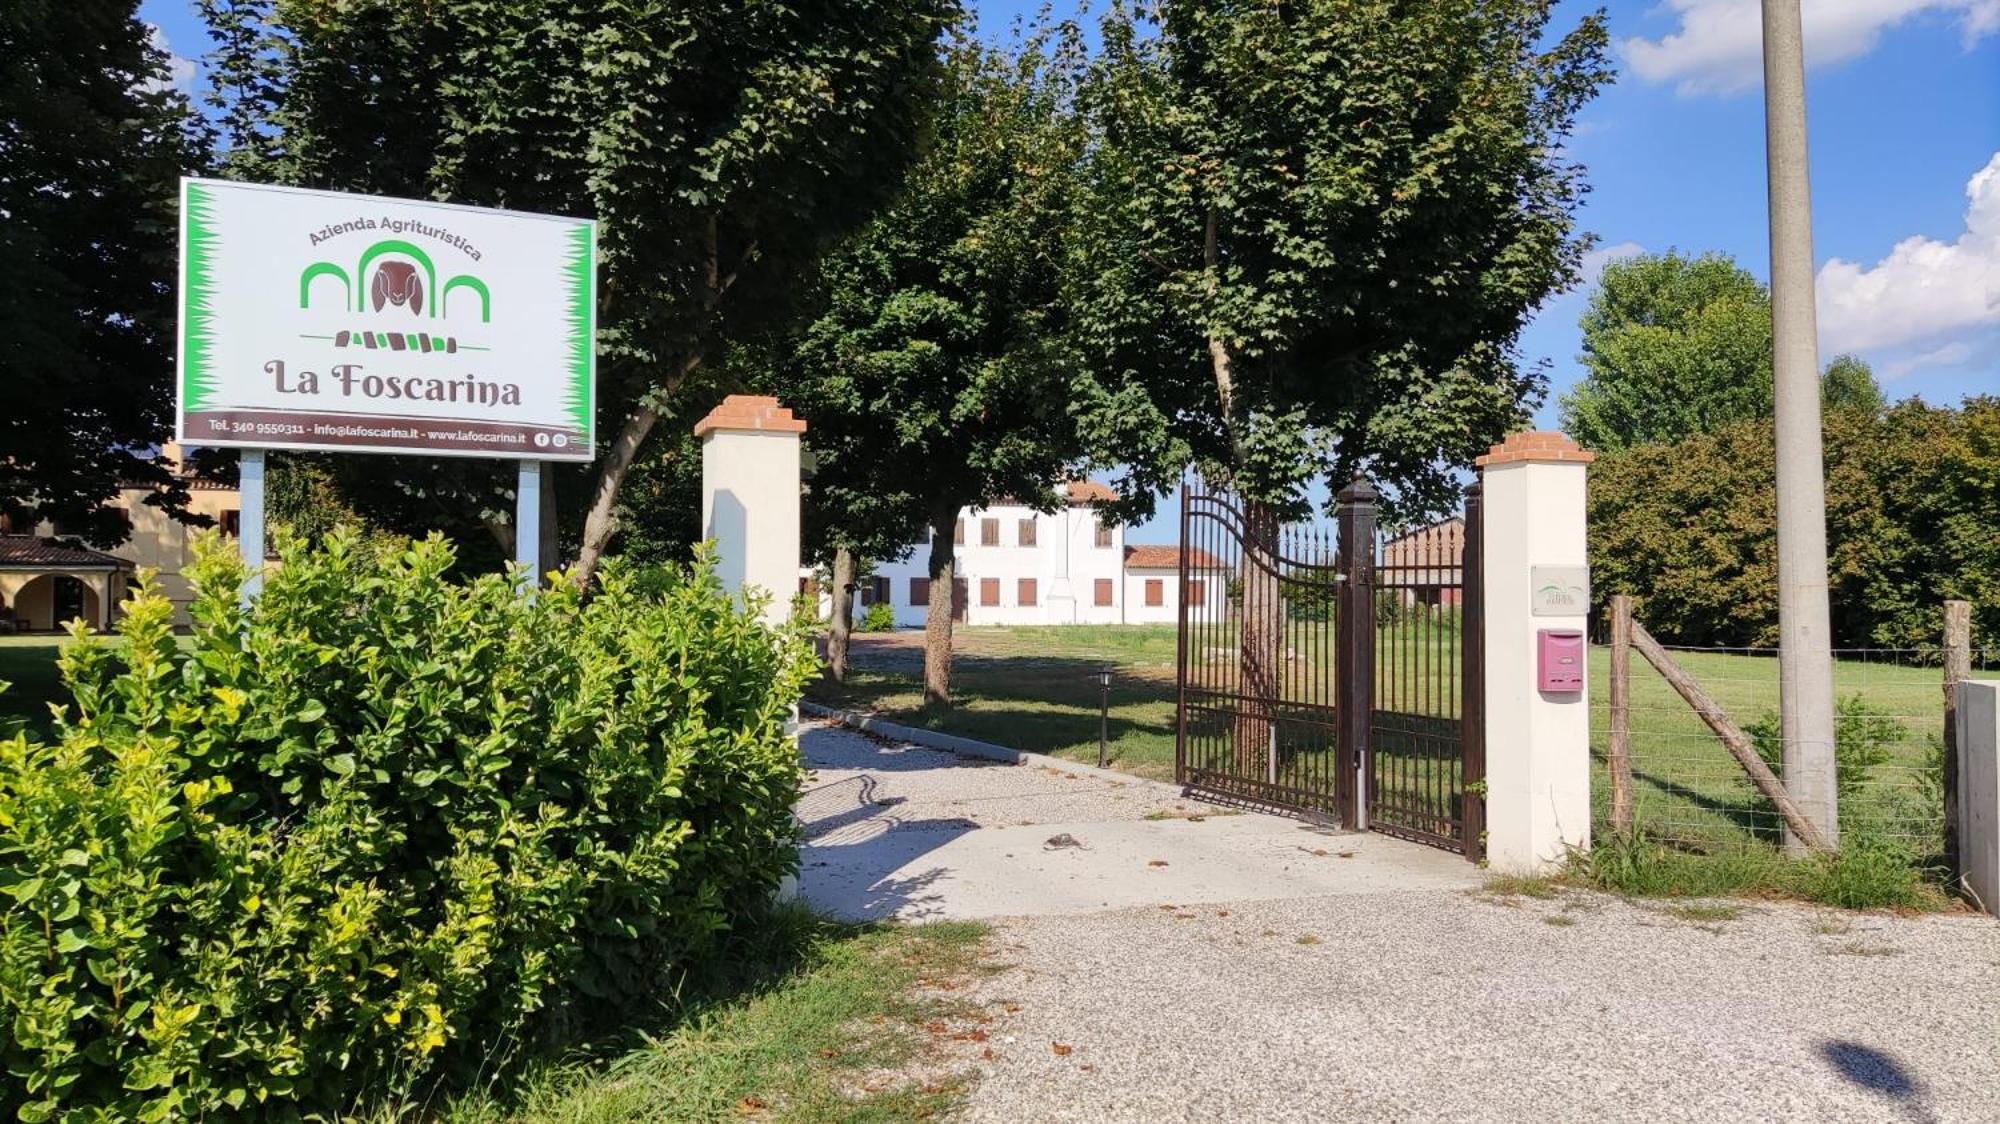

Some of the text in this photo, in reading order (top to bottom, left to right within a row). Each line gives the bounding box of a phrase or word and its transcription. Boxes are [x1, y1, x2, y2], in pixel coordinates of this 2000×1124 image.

[309, 217, 483, 262] Azienda Agrituristica
[264, 360, 522, 407] La Foscarina
[208, 419, 230, 431] Tel.
[232, 422, 254, 433] 340
[257, 424, 304, 435] 9550311
[314, 424, 418, 439] info@lafoscarina.it
[427, 430, 526, 443] www.lafoscarina.it
